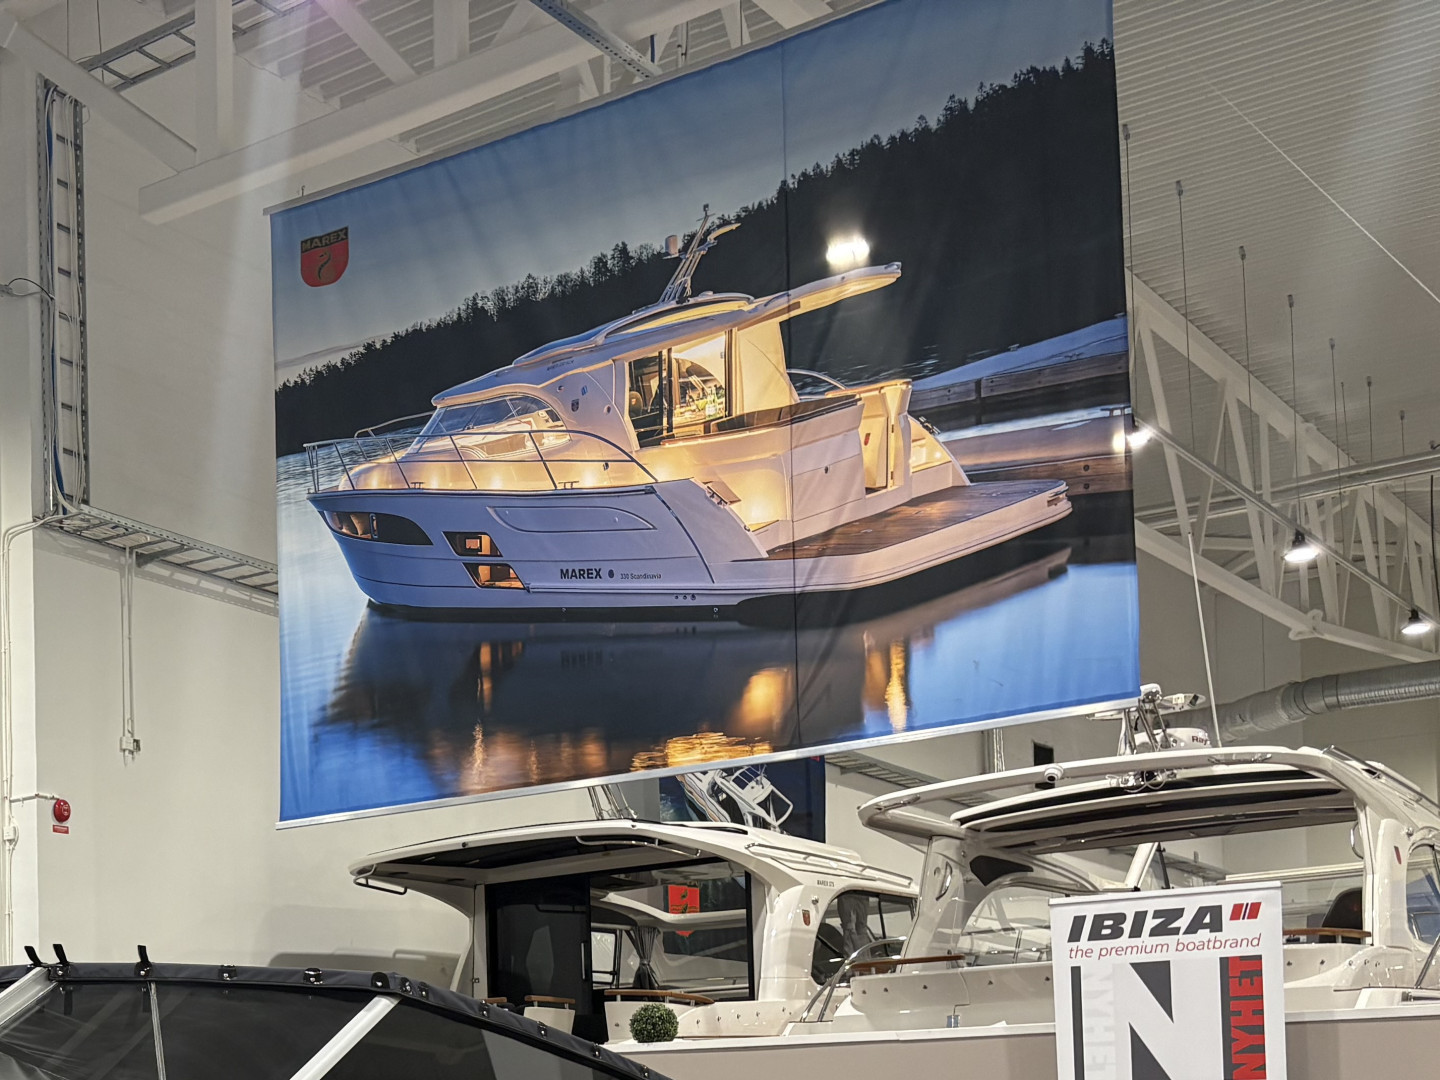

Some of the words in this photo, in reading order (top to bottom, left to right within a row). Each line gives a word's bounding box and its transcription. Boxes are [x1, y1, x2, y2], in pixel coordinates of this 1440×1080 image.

[303, 228, 347, 251] MAREX
[560, 568, 602, 580] MAREX
[1067, 904, 1223, 943] IBIZA
[1068, 945, 1093, 959] the
[1098, 940, 1170, 960] premium
[1175, 933, 1262, 952] boatbrand
[1228, 954, 1267, 1080] NYHET
